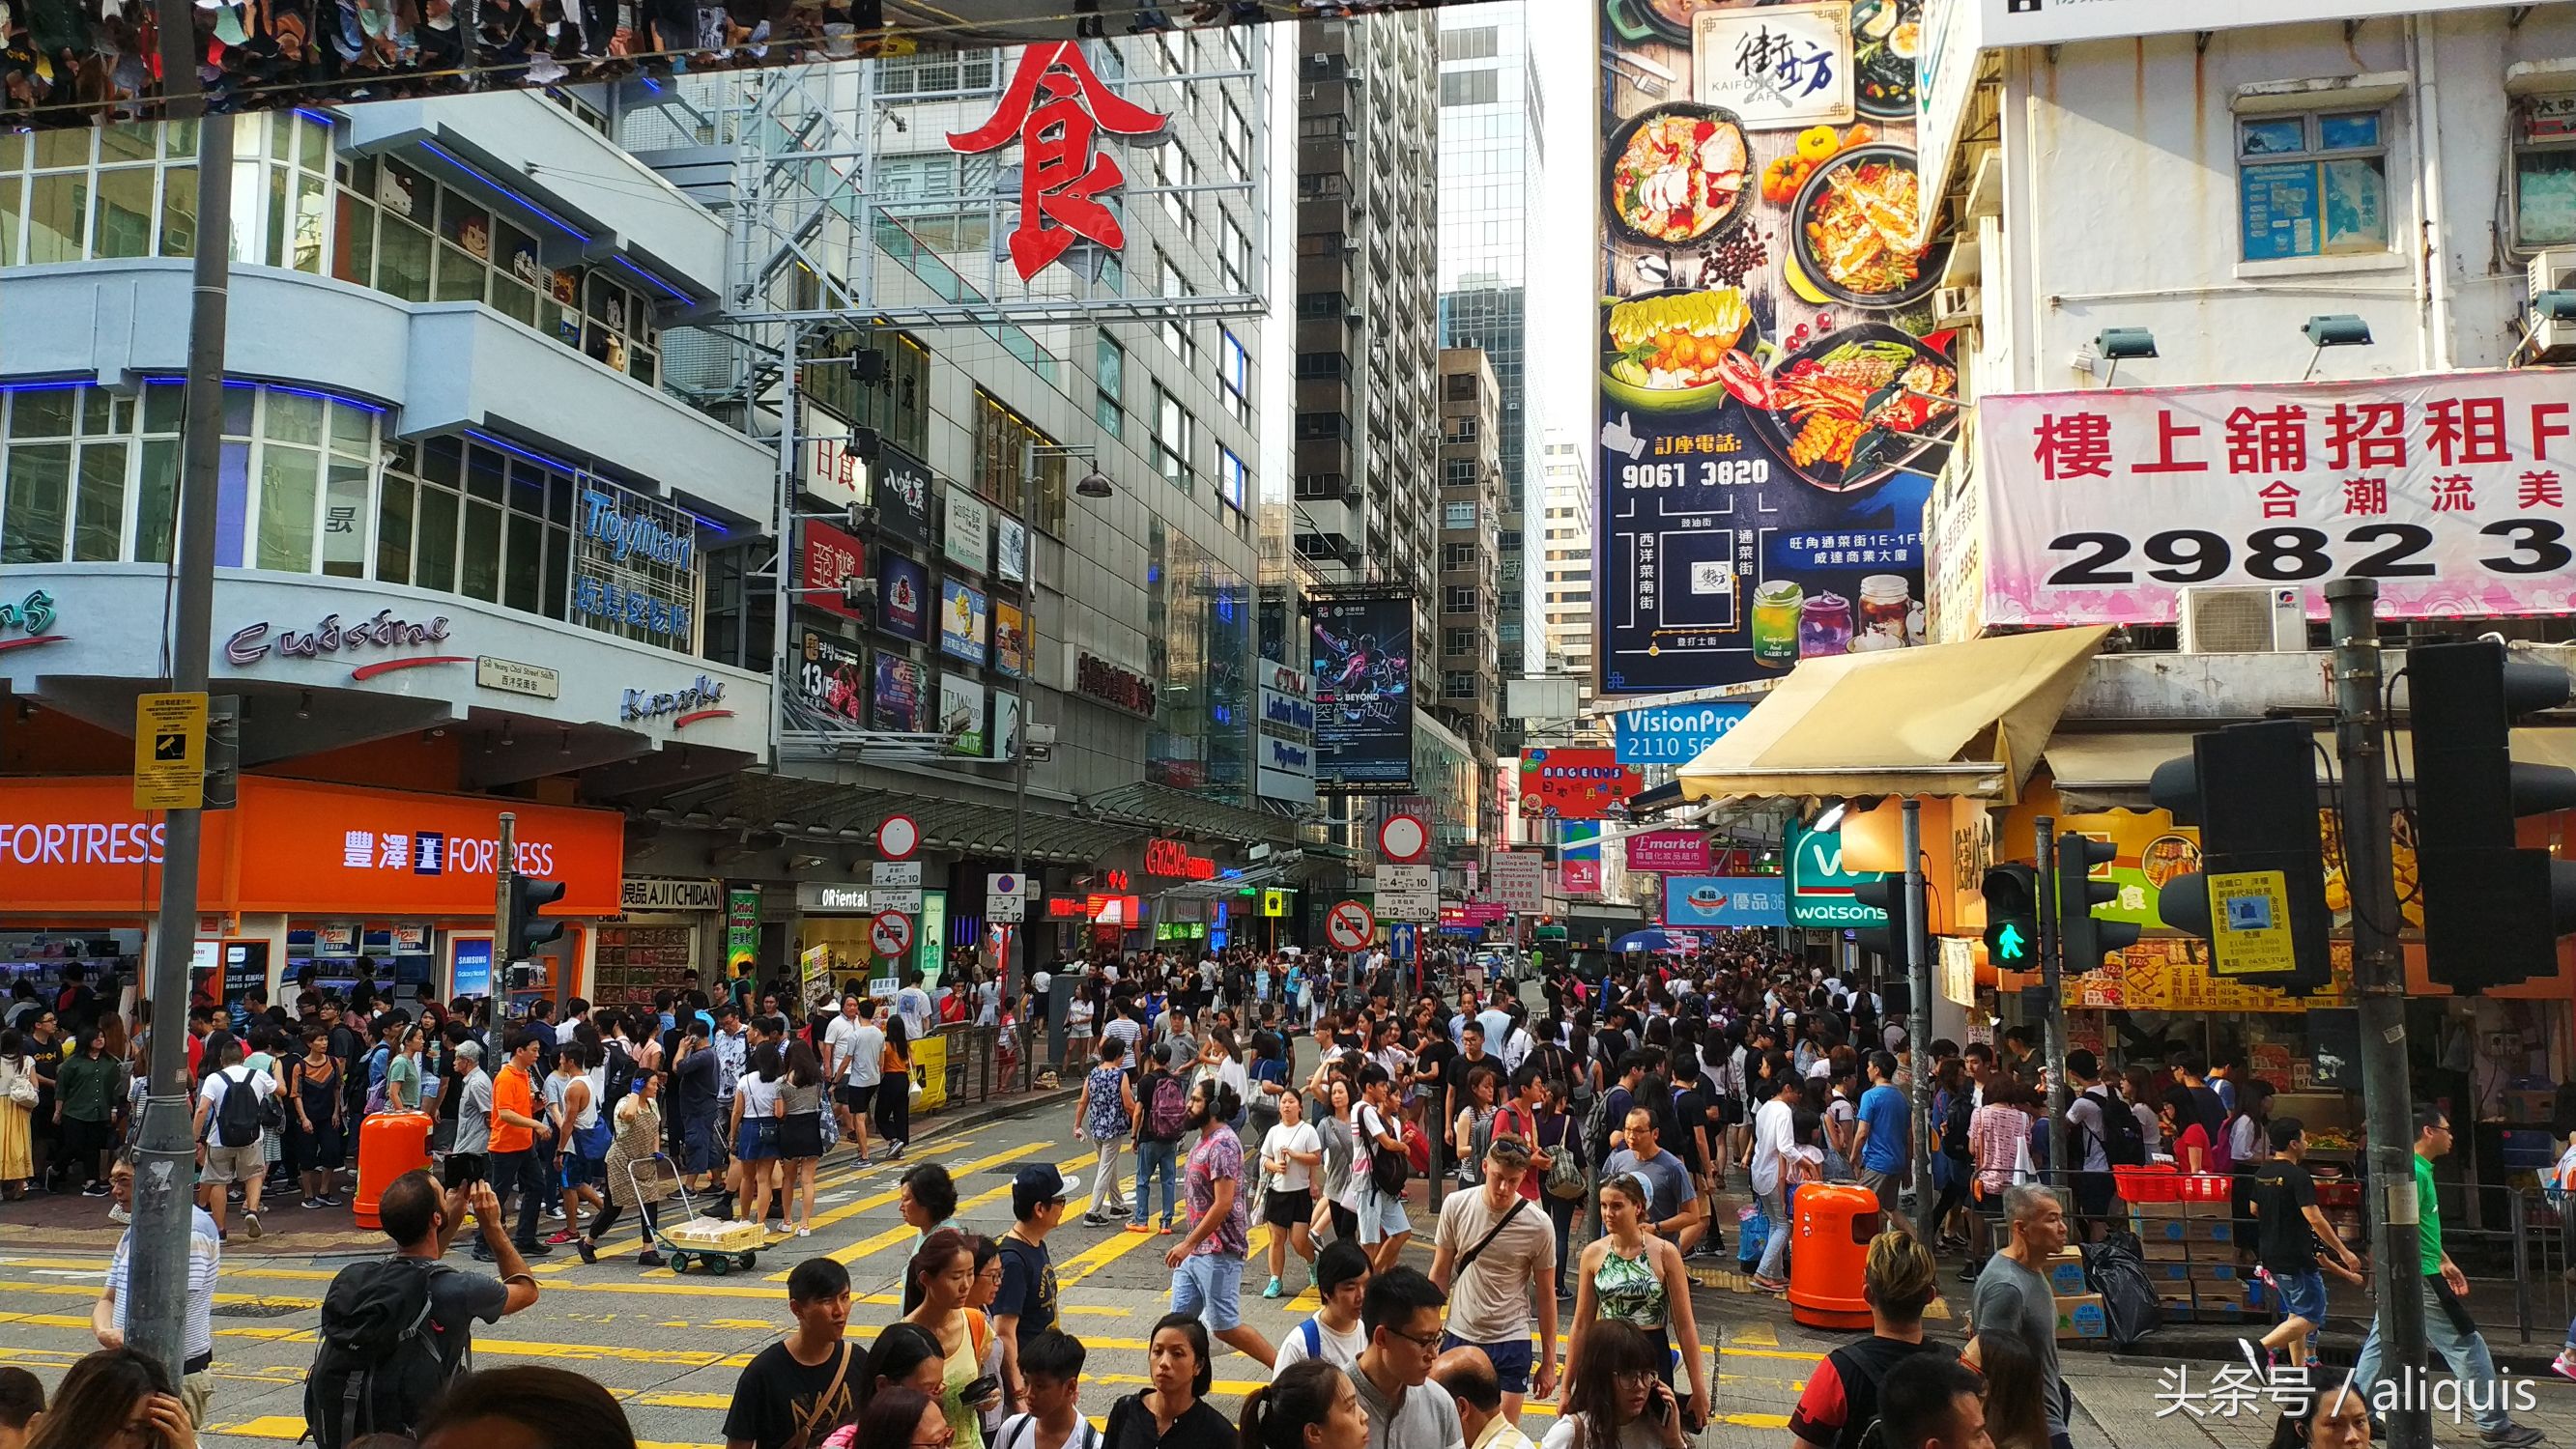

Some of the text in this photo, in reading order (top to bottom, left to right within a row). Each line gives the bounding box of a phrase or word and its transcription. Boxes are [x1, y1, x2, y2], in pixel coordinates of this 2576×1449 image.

[945, 41, 1174, 282] 食
[1621, 460, 1769, 490] 9061 3820
[1738, 529, 1754, 577] 通菜街
[1814, 549, 1908, 565] 威達商業大廈
[2047, 523, 2436, 585] 2982
[1640, 532, 1654, 611] 西洋菜南街
[1628, 737, 1720, 756] 2110 56
[1543, 766, 1622, 779] ANGEL'S
[343, 831, 408, 870] 豐澤
[908, 874, 919, 883] 10
[1417, 878, 1428, 887] 10
[648, 884, 669, 905] AJI
[672, 883, 718, 906] ICHIBAN
[732, 900, 754, 914] Dried
[909, 902, 919, 911] 10
[1417, 907, 1429, 916] 10
[1795, 905, 1888, 920] watsons
[1011, 913, 1021, 922] 12
[458, 955, 487, 964] SAMSUNG
